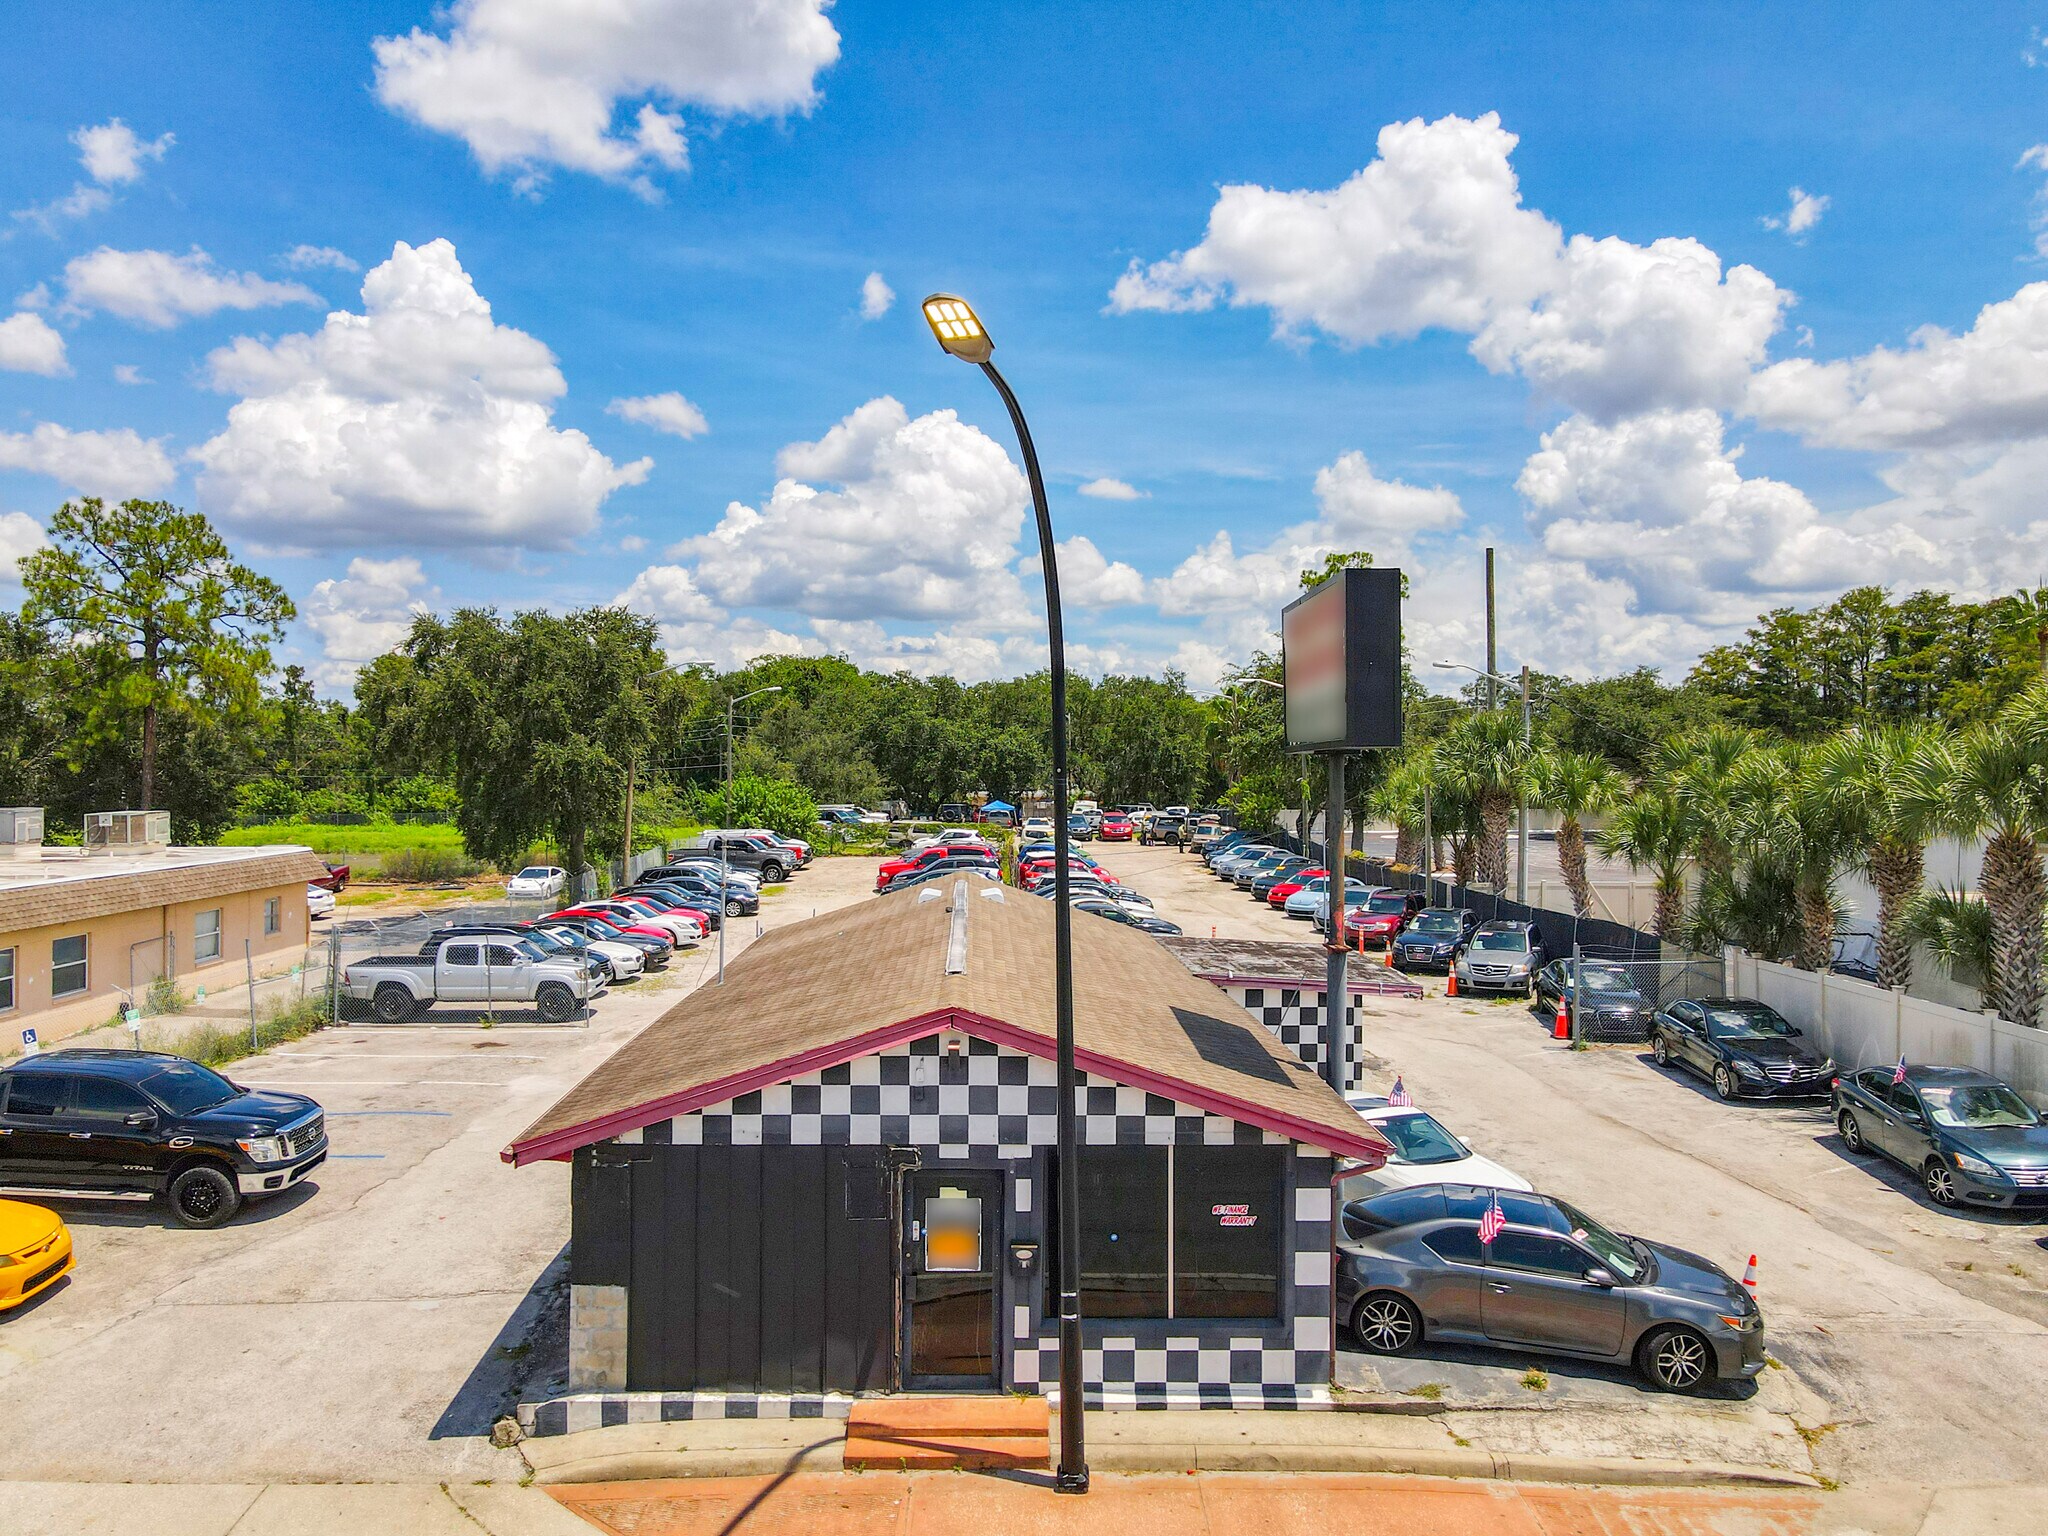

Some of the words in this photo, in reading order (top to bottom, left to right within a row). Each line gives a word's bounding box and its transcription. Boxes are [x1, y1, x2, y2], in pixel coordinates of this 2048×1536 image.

[1212, 1205, 1223, 1215] WE
[1223, 1205, 1249, 1215] FINANCE
[1220, 1215, 1257, 1226] WARRANTY
